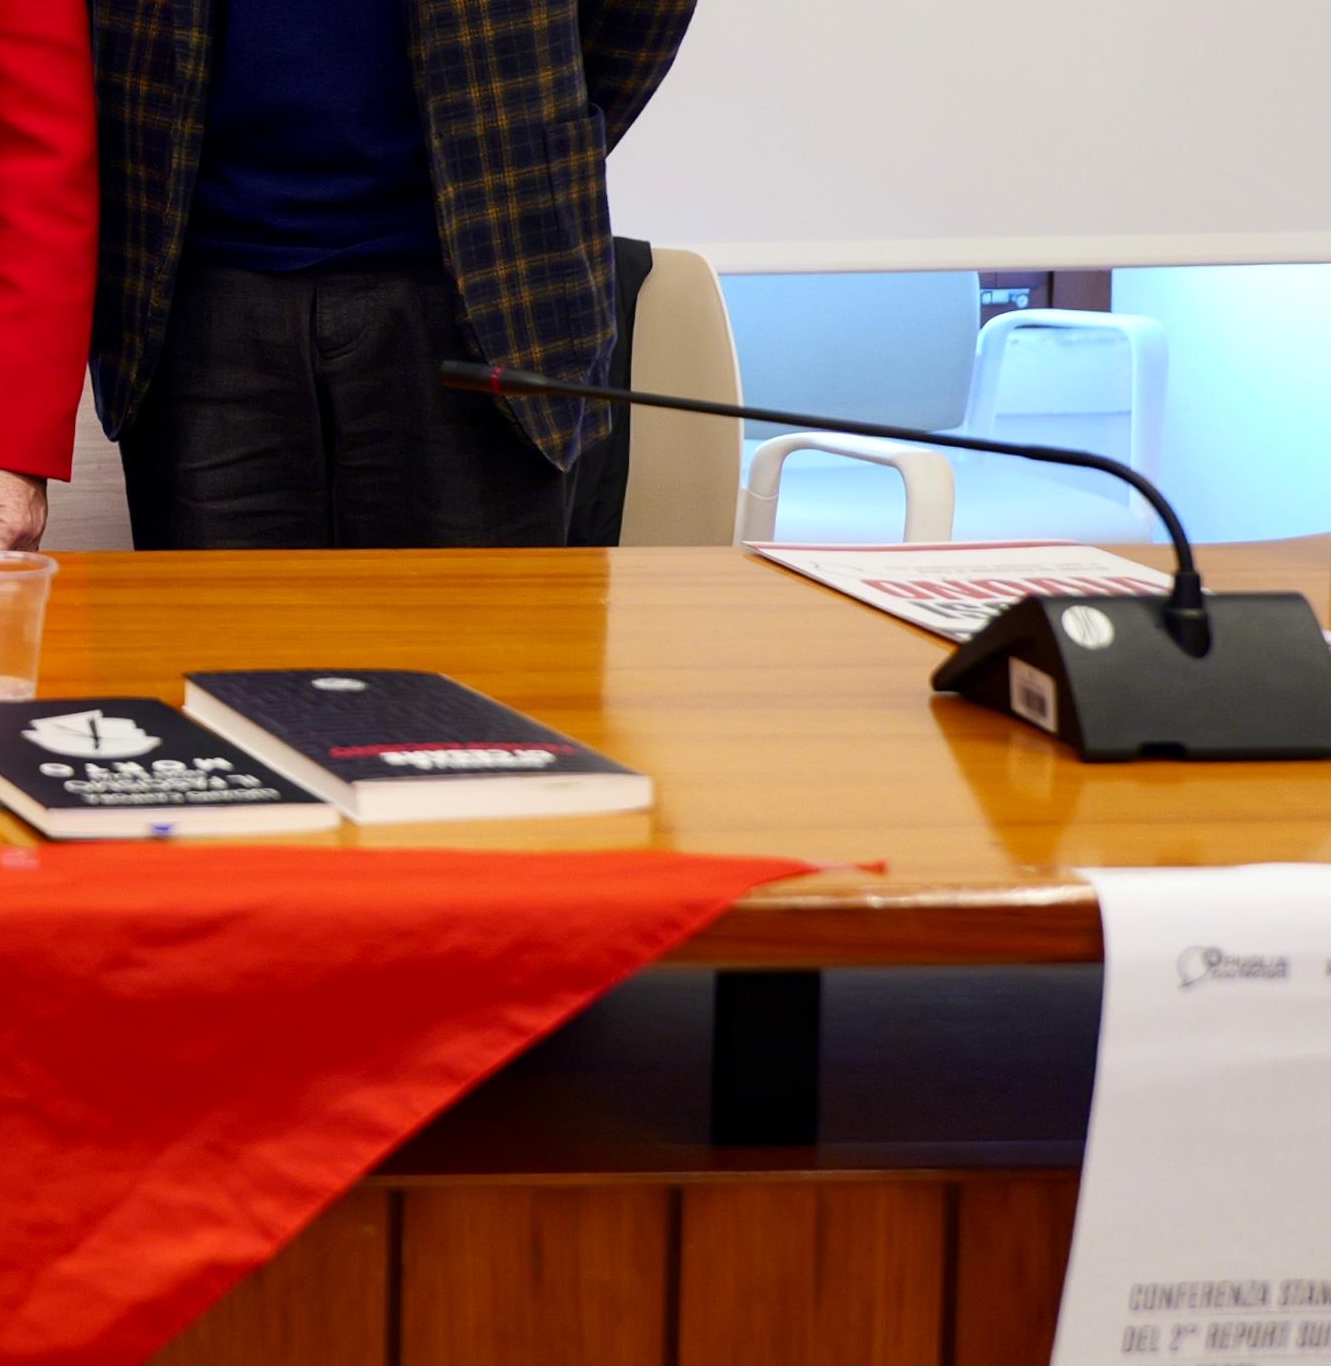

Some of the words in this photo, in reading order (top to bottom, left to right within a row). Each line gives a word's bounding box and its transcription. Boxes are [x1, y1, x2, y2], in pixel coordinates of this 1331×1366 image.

[1127, 1279, 1269, 1312] CONFERENZA
[1121, 1324, 1161, 1354] DEL
[1204, 1320, 1292, 1351] REPORT
